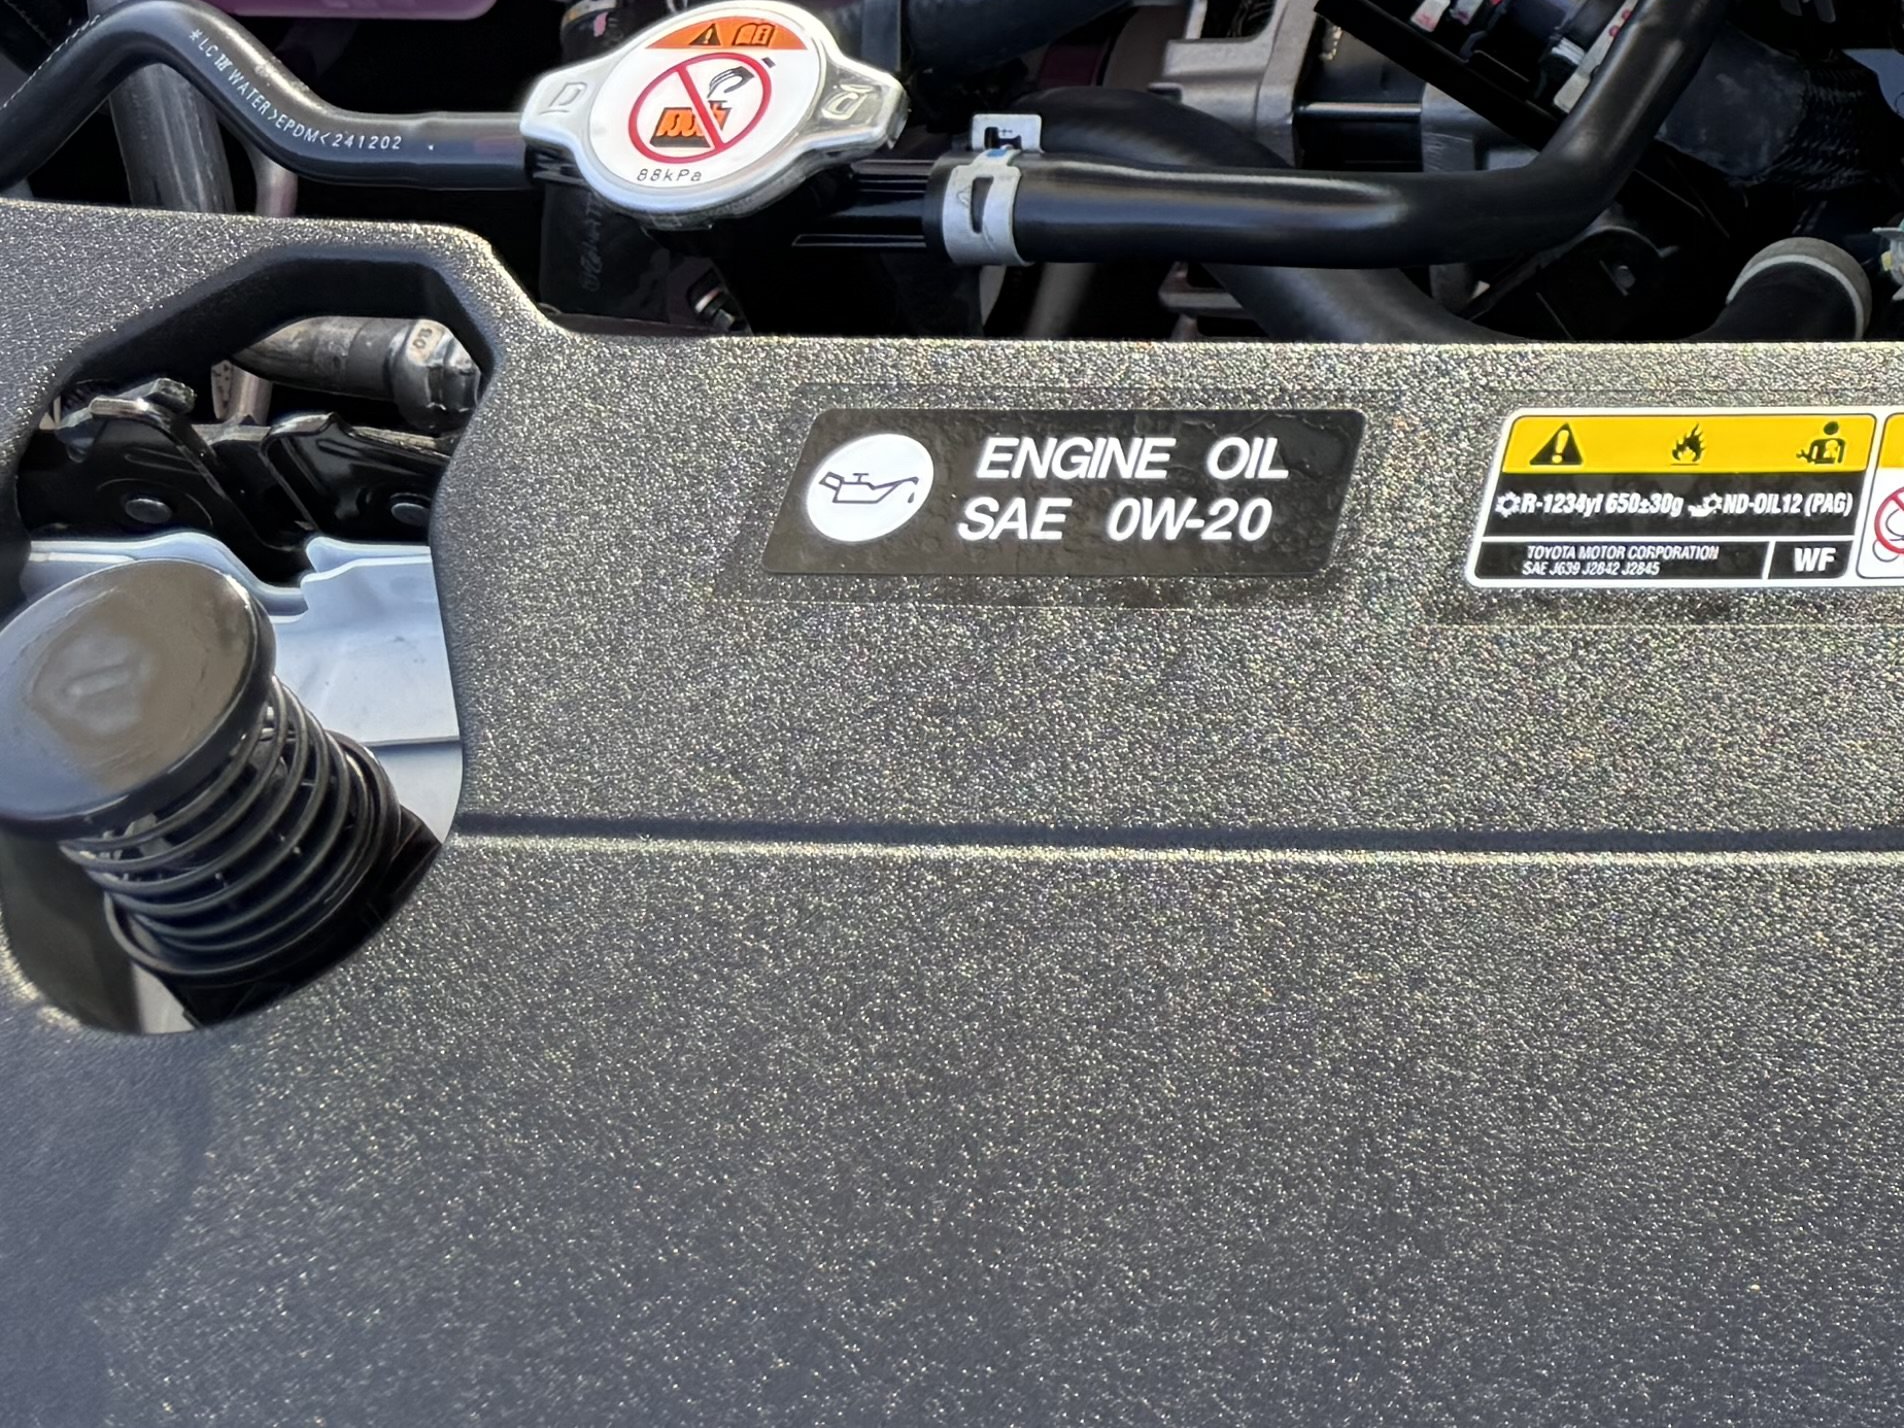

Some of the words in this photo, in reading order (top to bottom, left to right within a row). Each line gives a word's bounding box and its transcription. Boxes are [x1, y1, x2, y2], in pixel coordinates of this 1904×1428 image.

[228, 69, 272, 116] WATER
[332, 134, 402, 150] 241202
[637, 167, 703, 183] 88kPa
[975, 435, 1177, 482] ENGINE
[1203, 436, 1291, 482] OIL
[1603, 492, 1684, 518] 650±30g
[1804, 493, 1853, 519] (PAG)
[955, 496, 1070, 541] SAE
[1103, 496, 1275, 541] 0W-20
[1527, 545, 1575, 560] TOYOTA
[1578, 545, 1623, 560] MOTOR
[1626, 544, 1720, 560] CORPORATION
[1793, 548, 1835, 571] WF
[1521, 561, 1548, 576] SAE
[1549, 561, 1579, 576] J639
[1582, 561, 1619, 576] J2842
[1620, 561, 1660, 576] J2845
